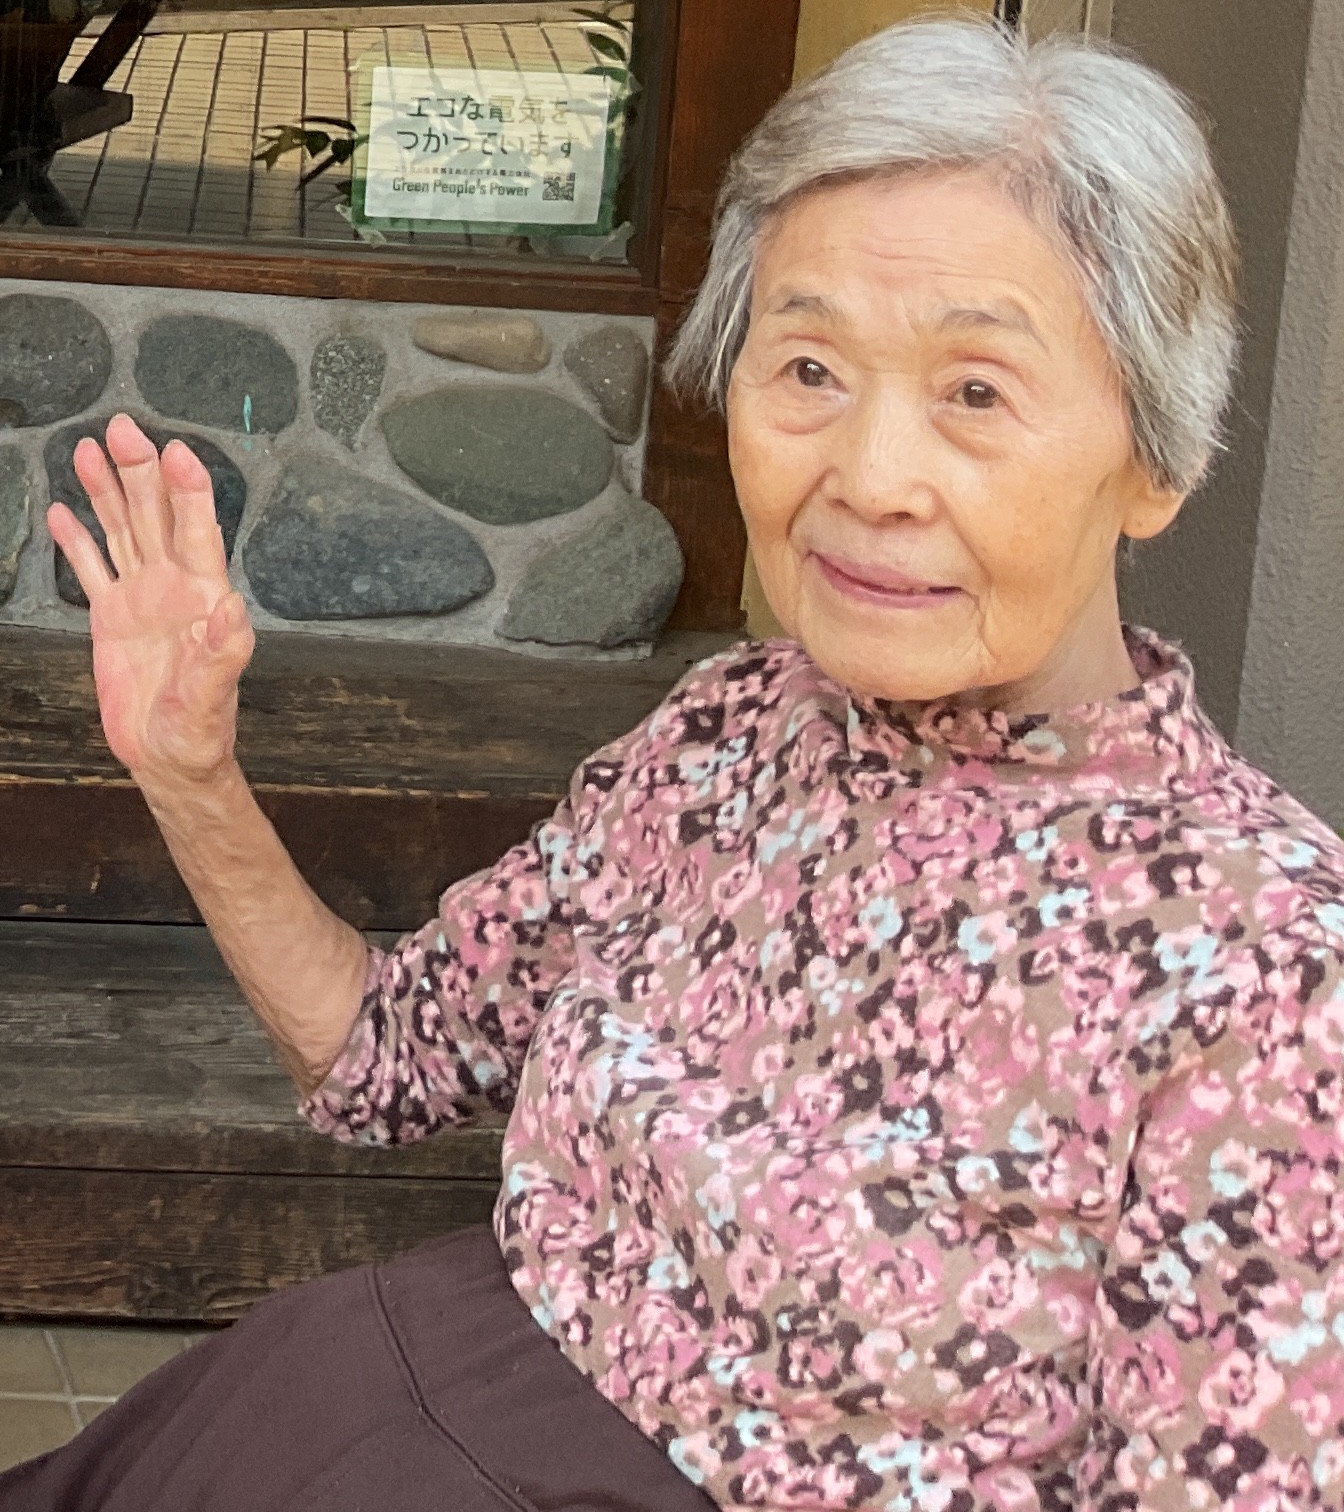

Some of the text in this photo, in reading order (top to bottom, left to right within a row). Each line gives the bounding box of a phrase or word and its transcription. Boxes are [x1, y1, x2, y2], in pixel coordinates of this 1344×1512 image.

[407, 95, 569, 124] エコな電気を
[397, 127, 579, 158] つかっています
[392, 177, 529, 198] Green People's Power
